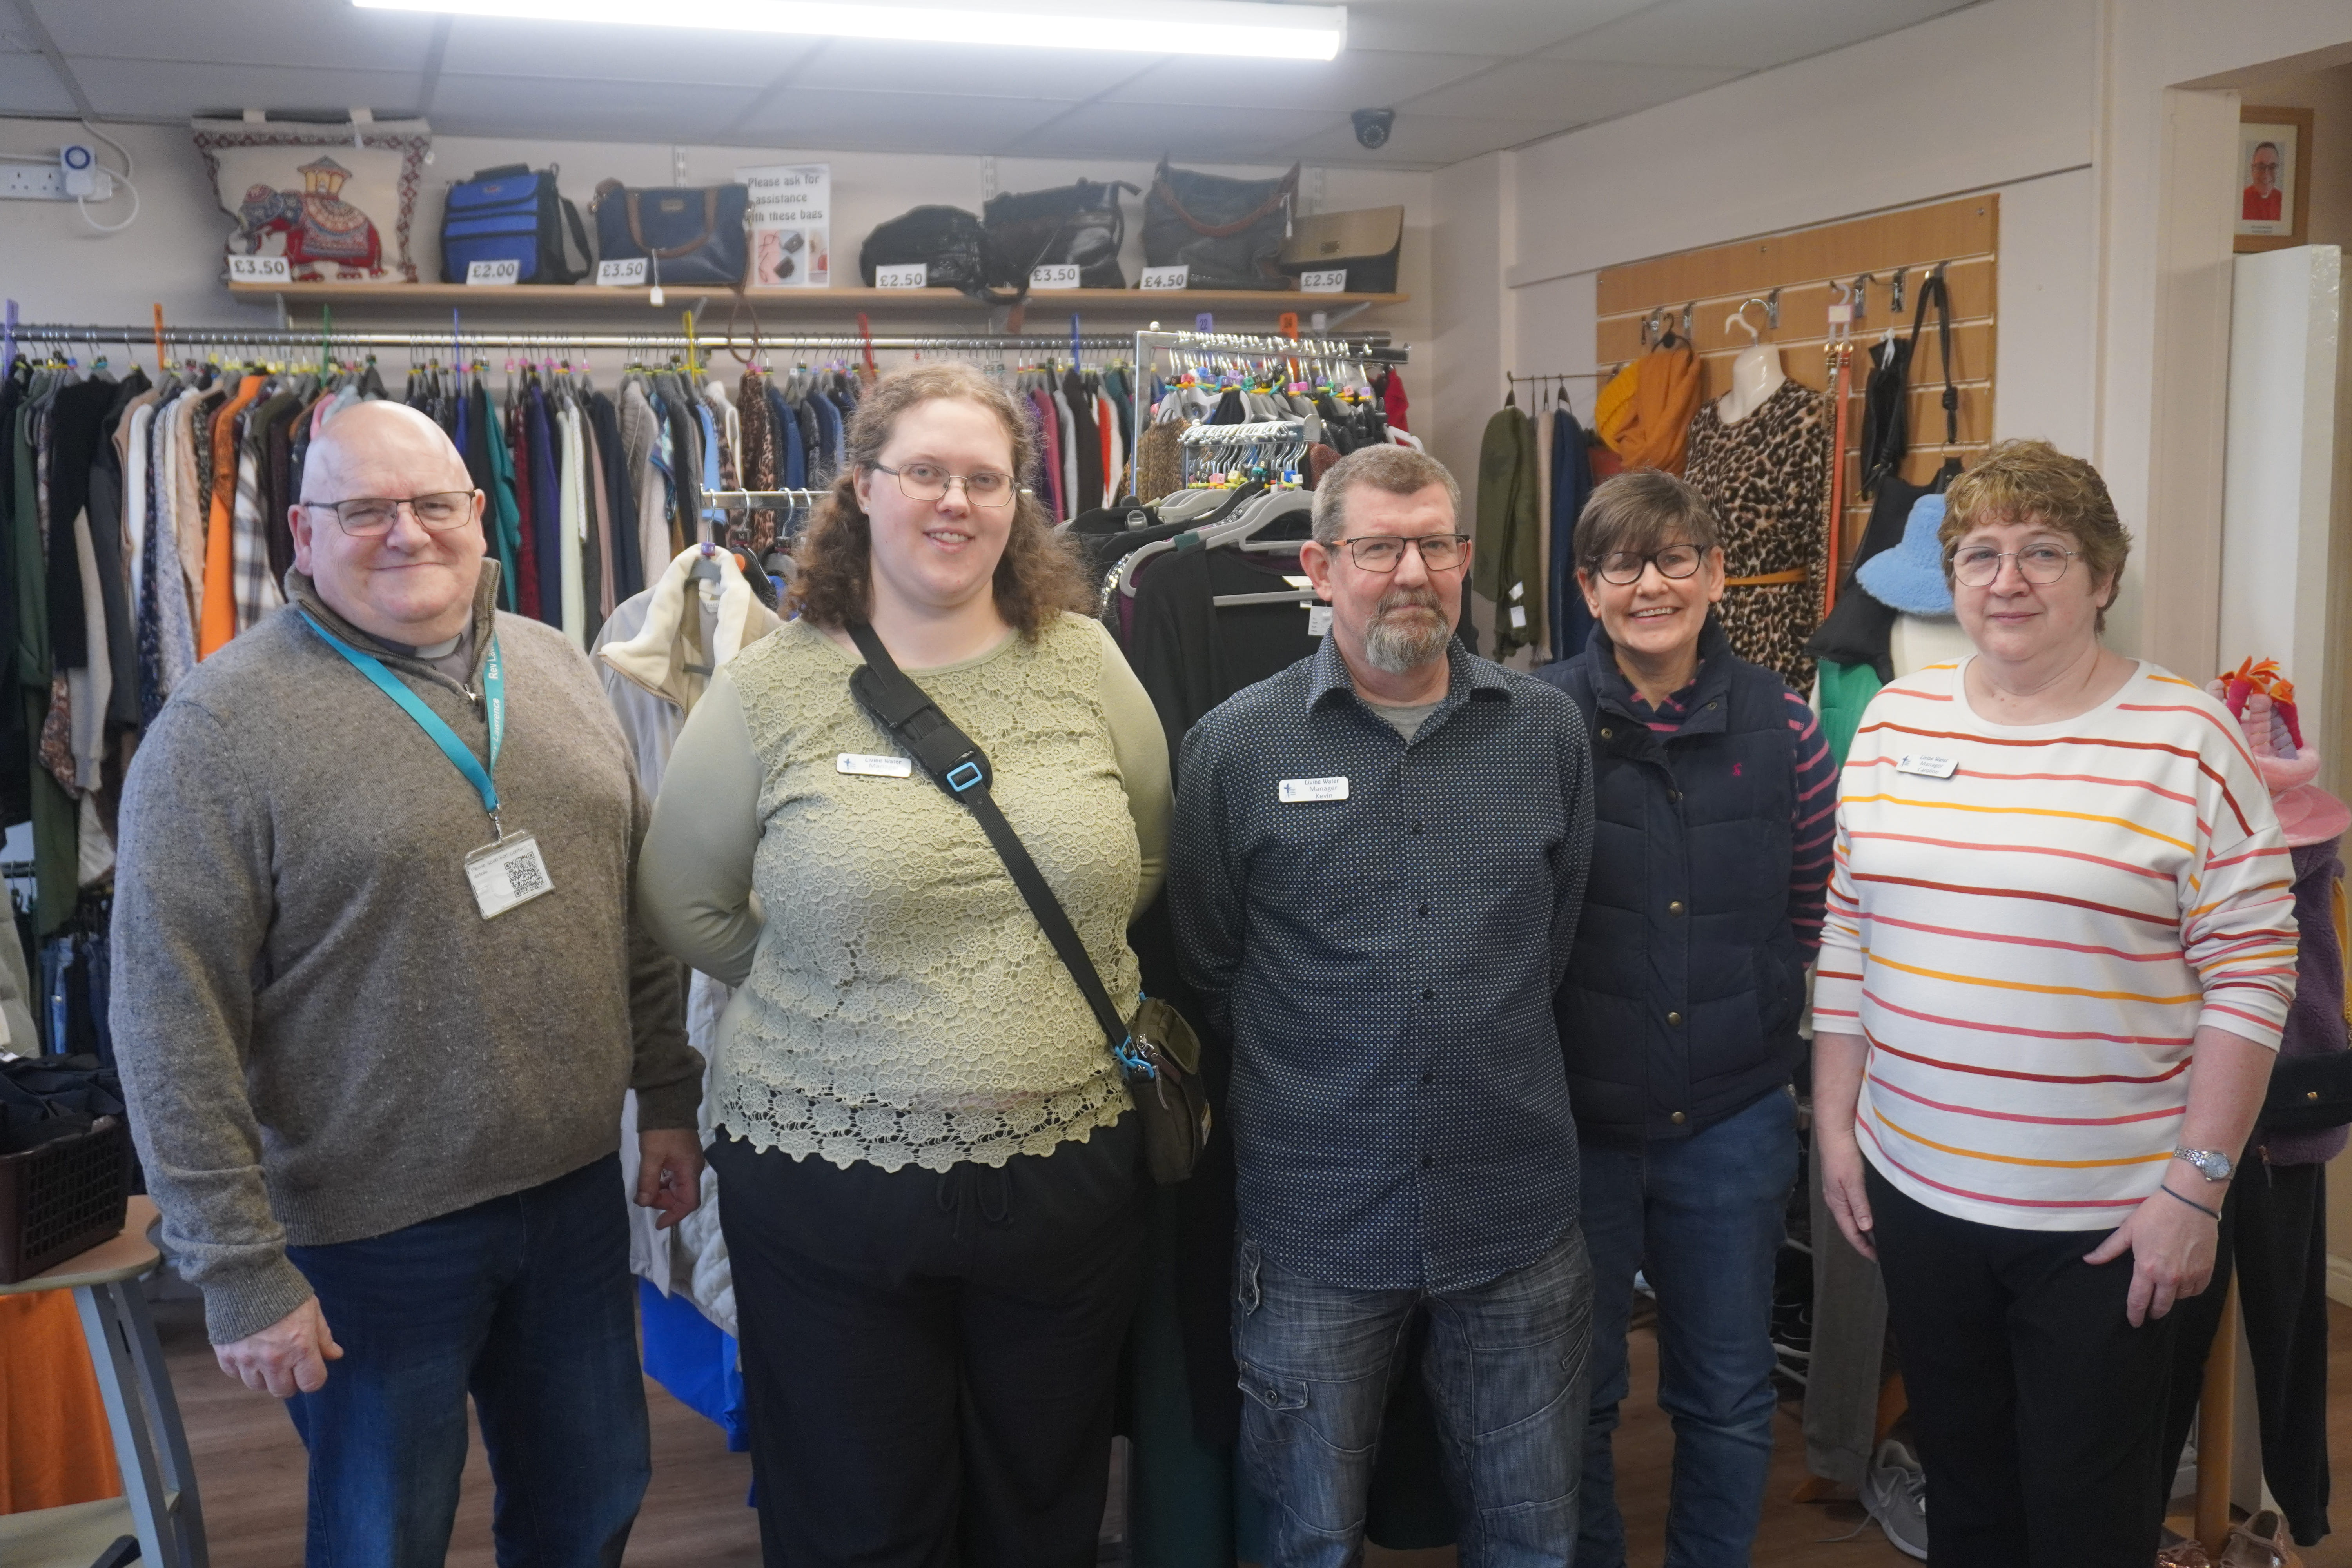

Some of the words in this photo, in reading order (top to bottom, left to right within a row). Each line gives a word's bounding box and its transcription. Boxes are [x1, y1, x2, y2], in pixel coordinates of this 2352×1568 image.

[748, 177, 780, 188] Please
[784, 175, 800, 186] ask
[805, 174, 820, 184] for
[755, 194, 808, 205] assistance
[769, 211, 796, 221] these
[800, 209, 823, 220] bags
[234, 260, 285, 275] £3.50
[472, 263, 515, 278] £2.00
[602, 262, 644, 276] £3.50
[1033, 268, 1076, 281] £3.50
[880, 273, 923, 287] £2.50
[1143, 274, 1184, 288] £4.50
[1304, 273, 1343, 287] £2.50
[1200, 319, 1207, 330] 22
[488, 663, 498, 679] Rev
[471, 863, 486, 872] Please
